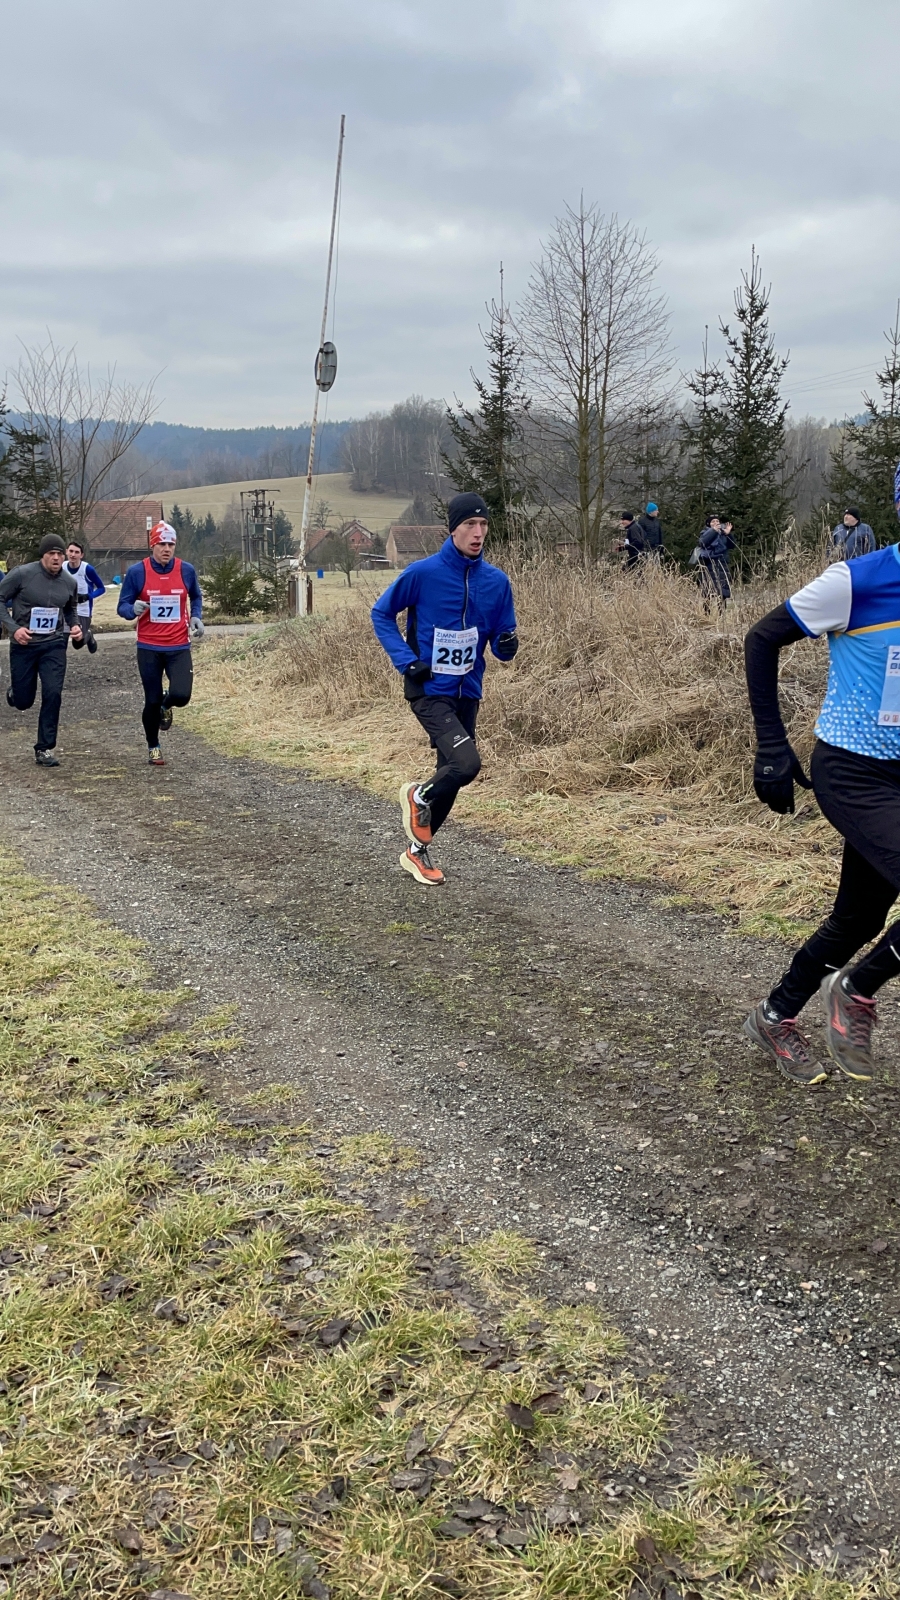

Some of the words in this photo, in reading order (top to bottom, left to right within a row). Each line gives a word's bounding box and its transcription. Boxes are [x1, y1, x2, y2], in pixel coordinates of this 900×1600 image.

[158, 606, 173, 617] 27
[36, 618, 54, 628] 121
[436, 646, 473, 666] 282
